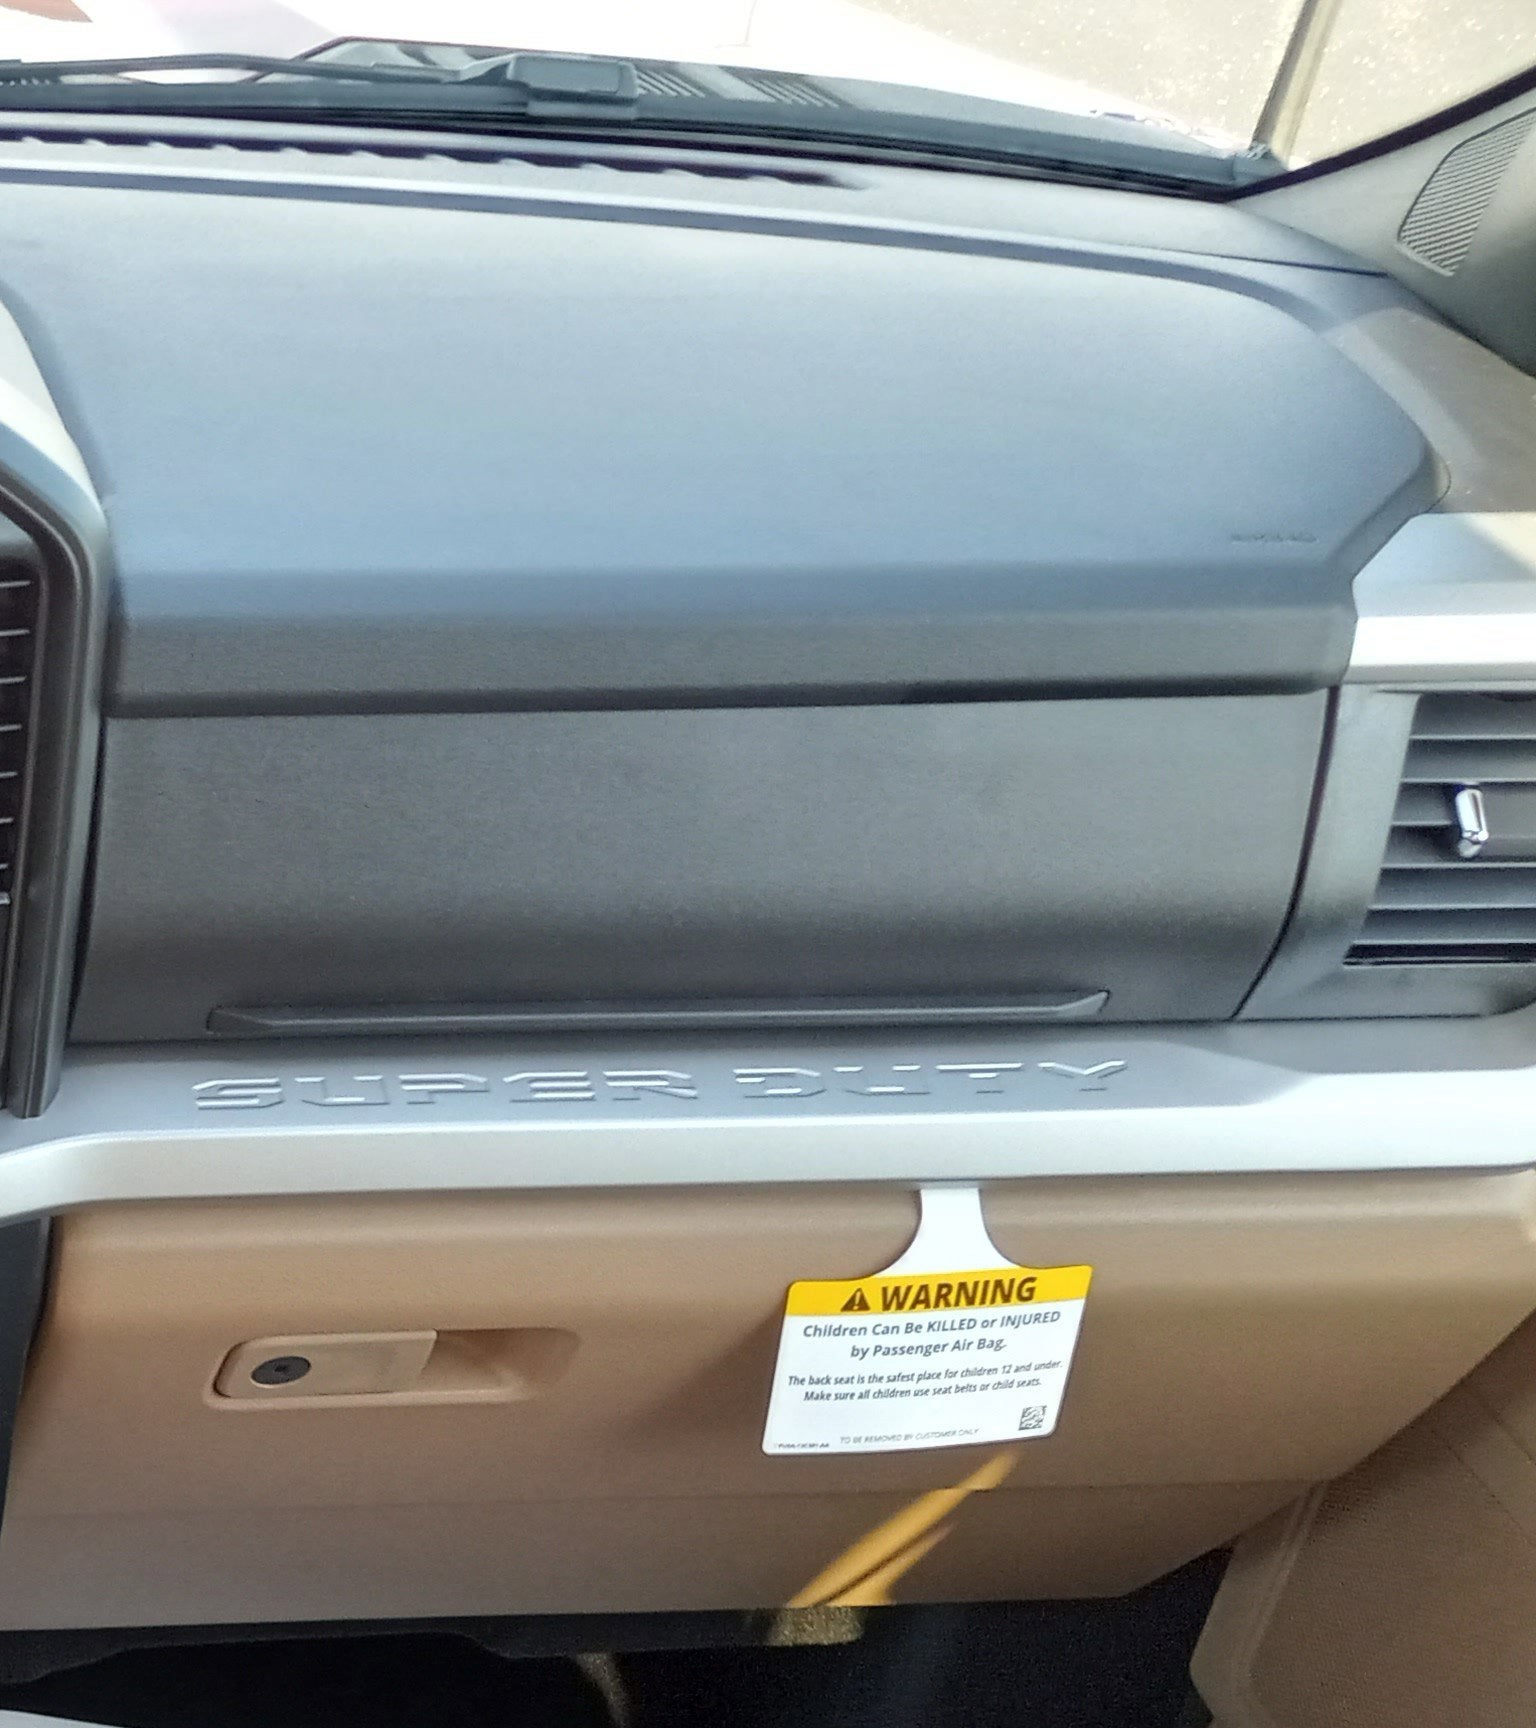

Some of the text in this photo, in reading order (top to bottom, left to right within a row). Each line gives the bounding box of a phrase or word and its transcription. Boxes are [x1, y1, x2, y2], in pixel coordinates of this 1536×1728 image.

[193, 1060, 1127, 1110] SUPER DUTY
[881, 1276, 1038, 1311] WARNING
[803, 1311, 1061, 1338] Children Can Be KILLED or INJURED
[850, 1345, 869, 1360] by
[873, 1343, 949, 1357] Passenger
[951, 1339, 974, 1352] Air
[788, 1375, 806, 1386] The
[808, 1373, 832, 1385] back
[834, 1374, 855, 1385] seat
[857, 1374, 866, 1384] is
[868, 1372, 884, 1384] the
[886, 1370, 915, 1383] safest
[916, 1369, 942, 1384] place
[944, 1368, 959, 1380] for
[961, 1366, 999, 1378] children
[1001, 1363, 1012, 1375] 12
[1013, 1361, 1033, 1373] and
[804, 1389, 832, 1402] Make
[834, 1390, 856, 1401] sure
[858, 1389, 870, 1400] all
[872, 1386, 911, 1399] children
[914, 1387, 929, 1397] use
[932, 1385, 952, 1396] seat
[954, 1382, 977, 1395] belts
[979, 1383, 989, 1392] or
[992, 1379, 1014, 1391] child
